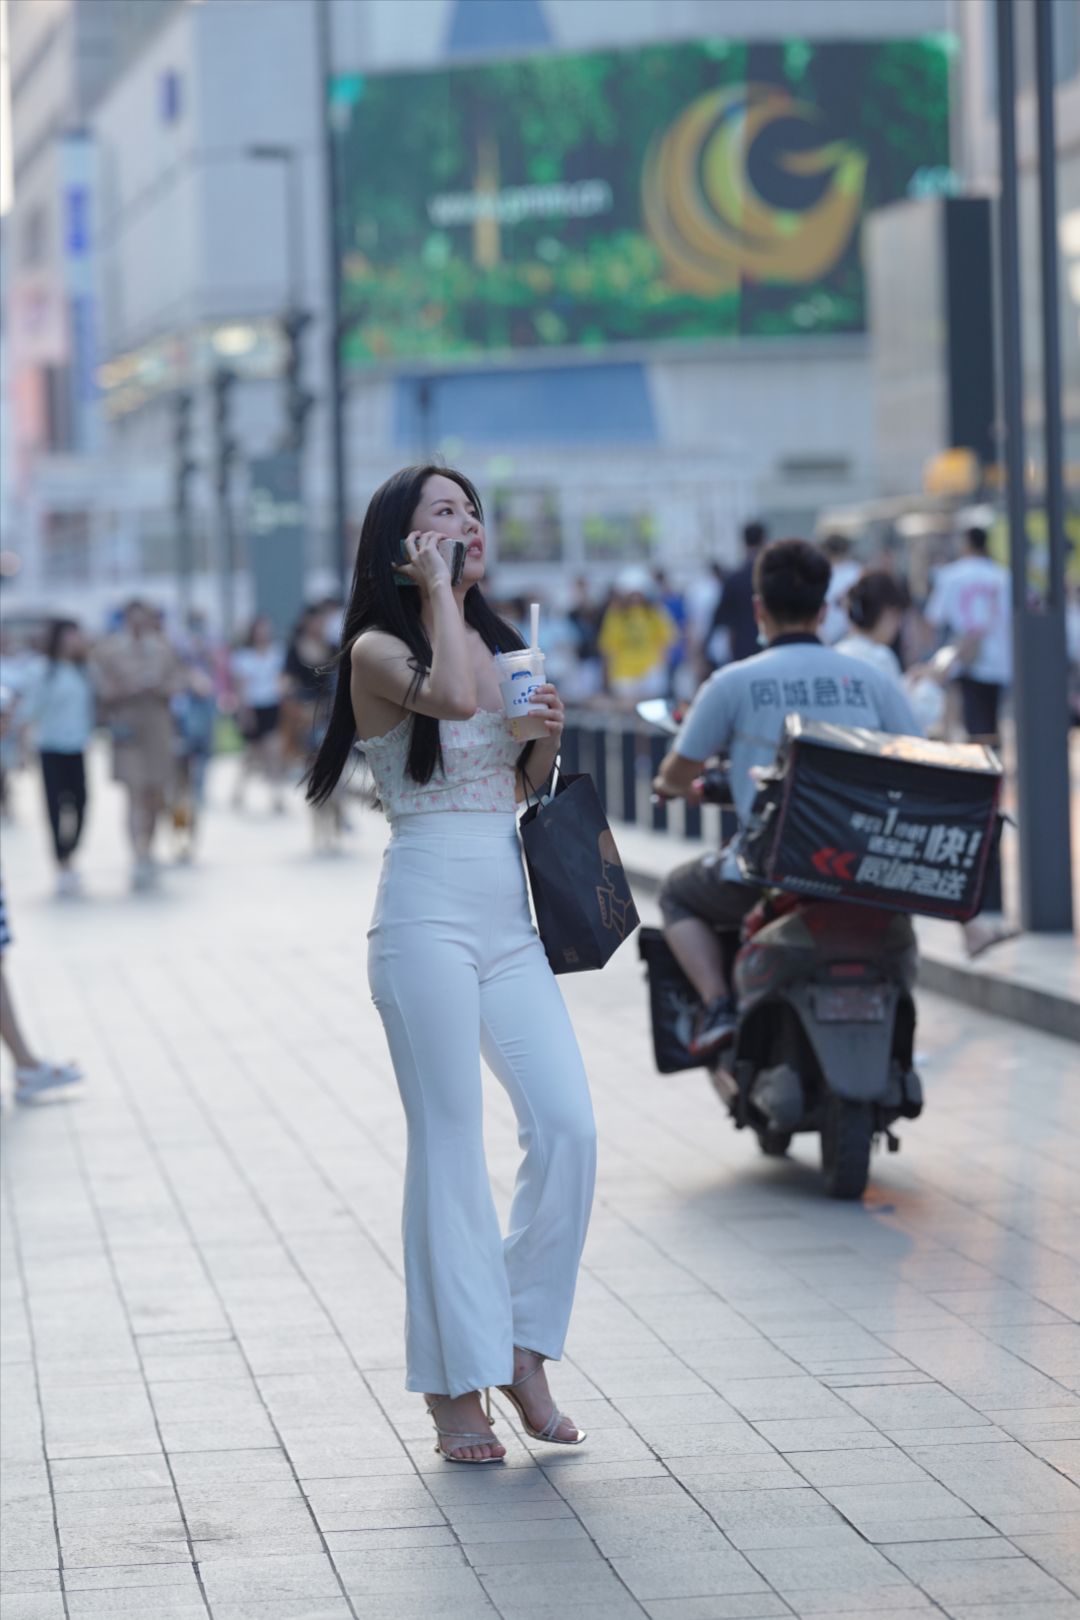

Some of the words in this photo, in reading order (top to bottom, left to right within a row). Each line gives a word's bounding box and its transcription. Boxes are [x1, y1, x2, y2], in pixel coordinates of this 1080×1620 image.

[750, 675, 868, 712] 同城急送
[855, 855, 967, 900] 同城急送
